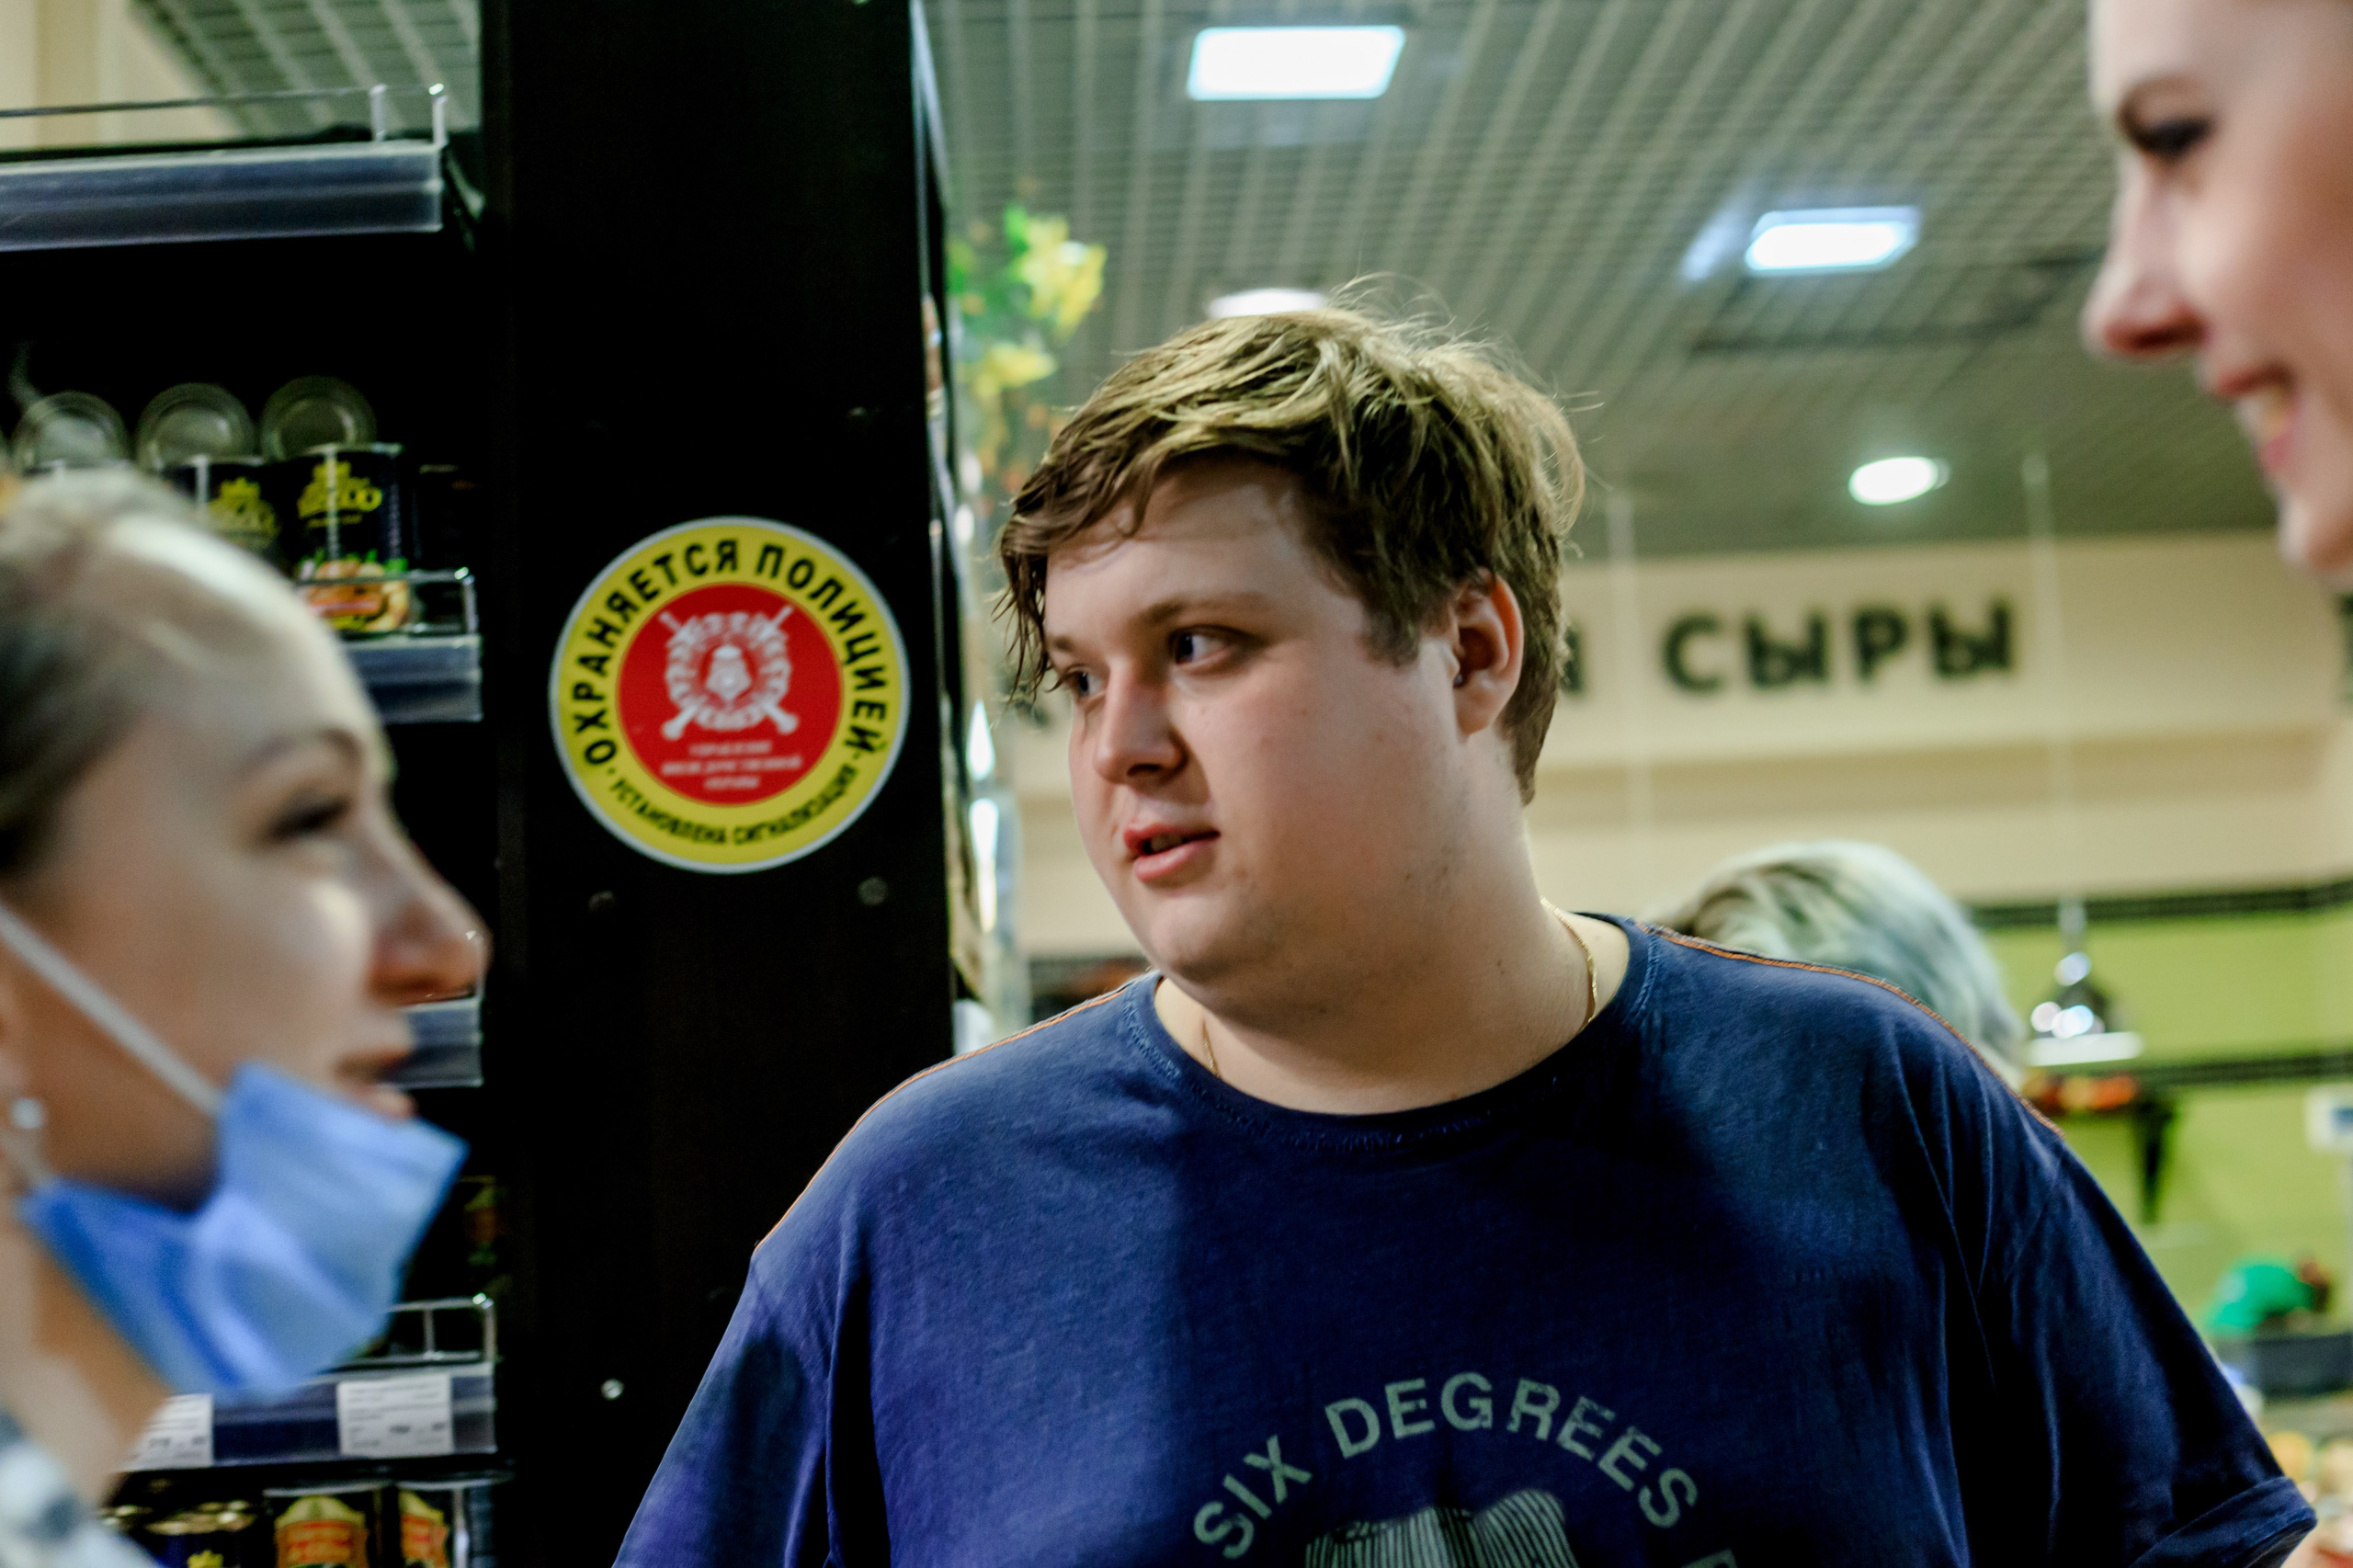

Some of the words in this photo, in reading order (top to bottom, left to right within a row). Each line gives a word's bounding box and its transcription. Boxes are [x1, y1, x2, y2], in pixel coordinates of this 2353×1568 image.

[573, 539, 738, 767] ОХРАНЯЕТСЯ
[756, 544, 888, 754] ПОЛИЦИЕЙ
[1662, 597, 2016, 693] СЫРЫ
[609, 778, 727, 845] УСТАНОВЛЕНА
[1194, 1435, 1312, 1559] SIX
[1324, 1372, 1698, 1528] DEGREES
